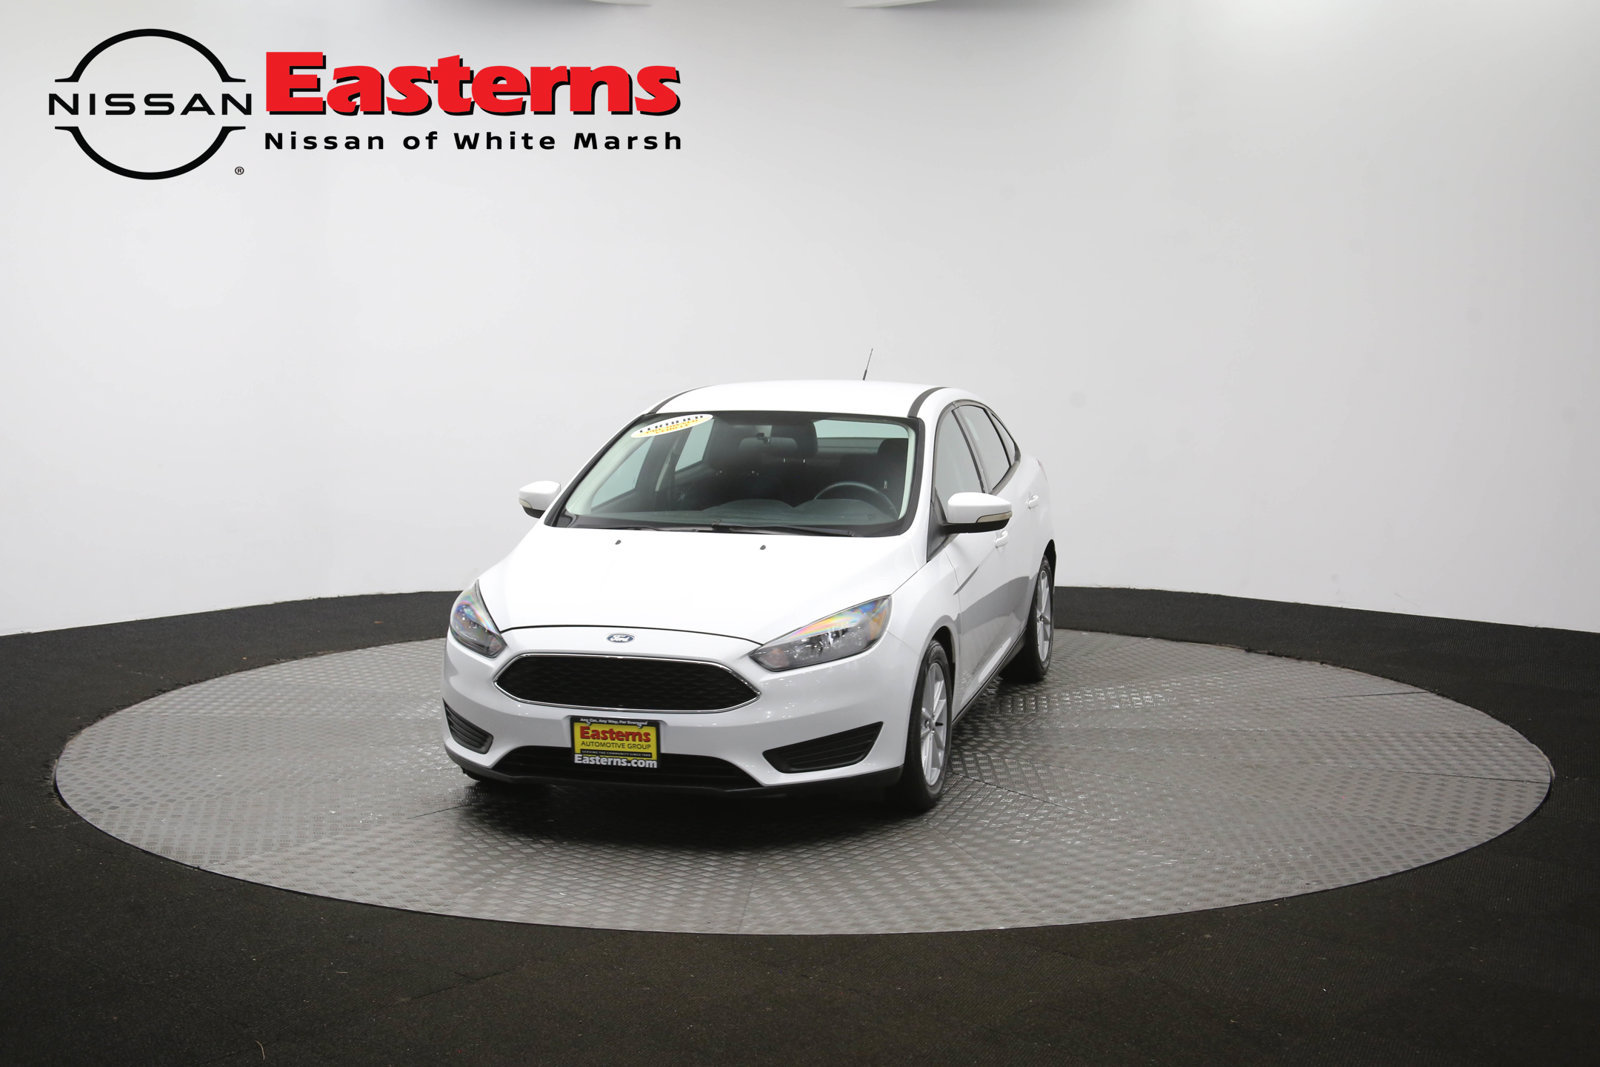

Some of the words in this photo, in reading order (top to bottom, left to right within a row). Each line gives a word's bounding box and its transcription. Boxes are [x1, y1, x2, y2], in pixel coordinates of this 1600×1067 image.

[580, 726, 651, 742] Easterns
[581, 741, 625, 749] AUTOMOTIVE
[574, 754, 657, 768] Easterns.com
